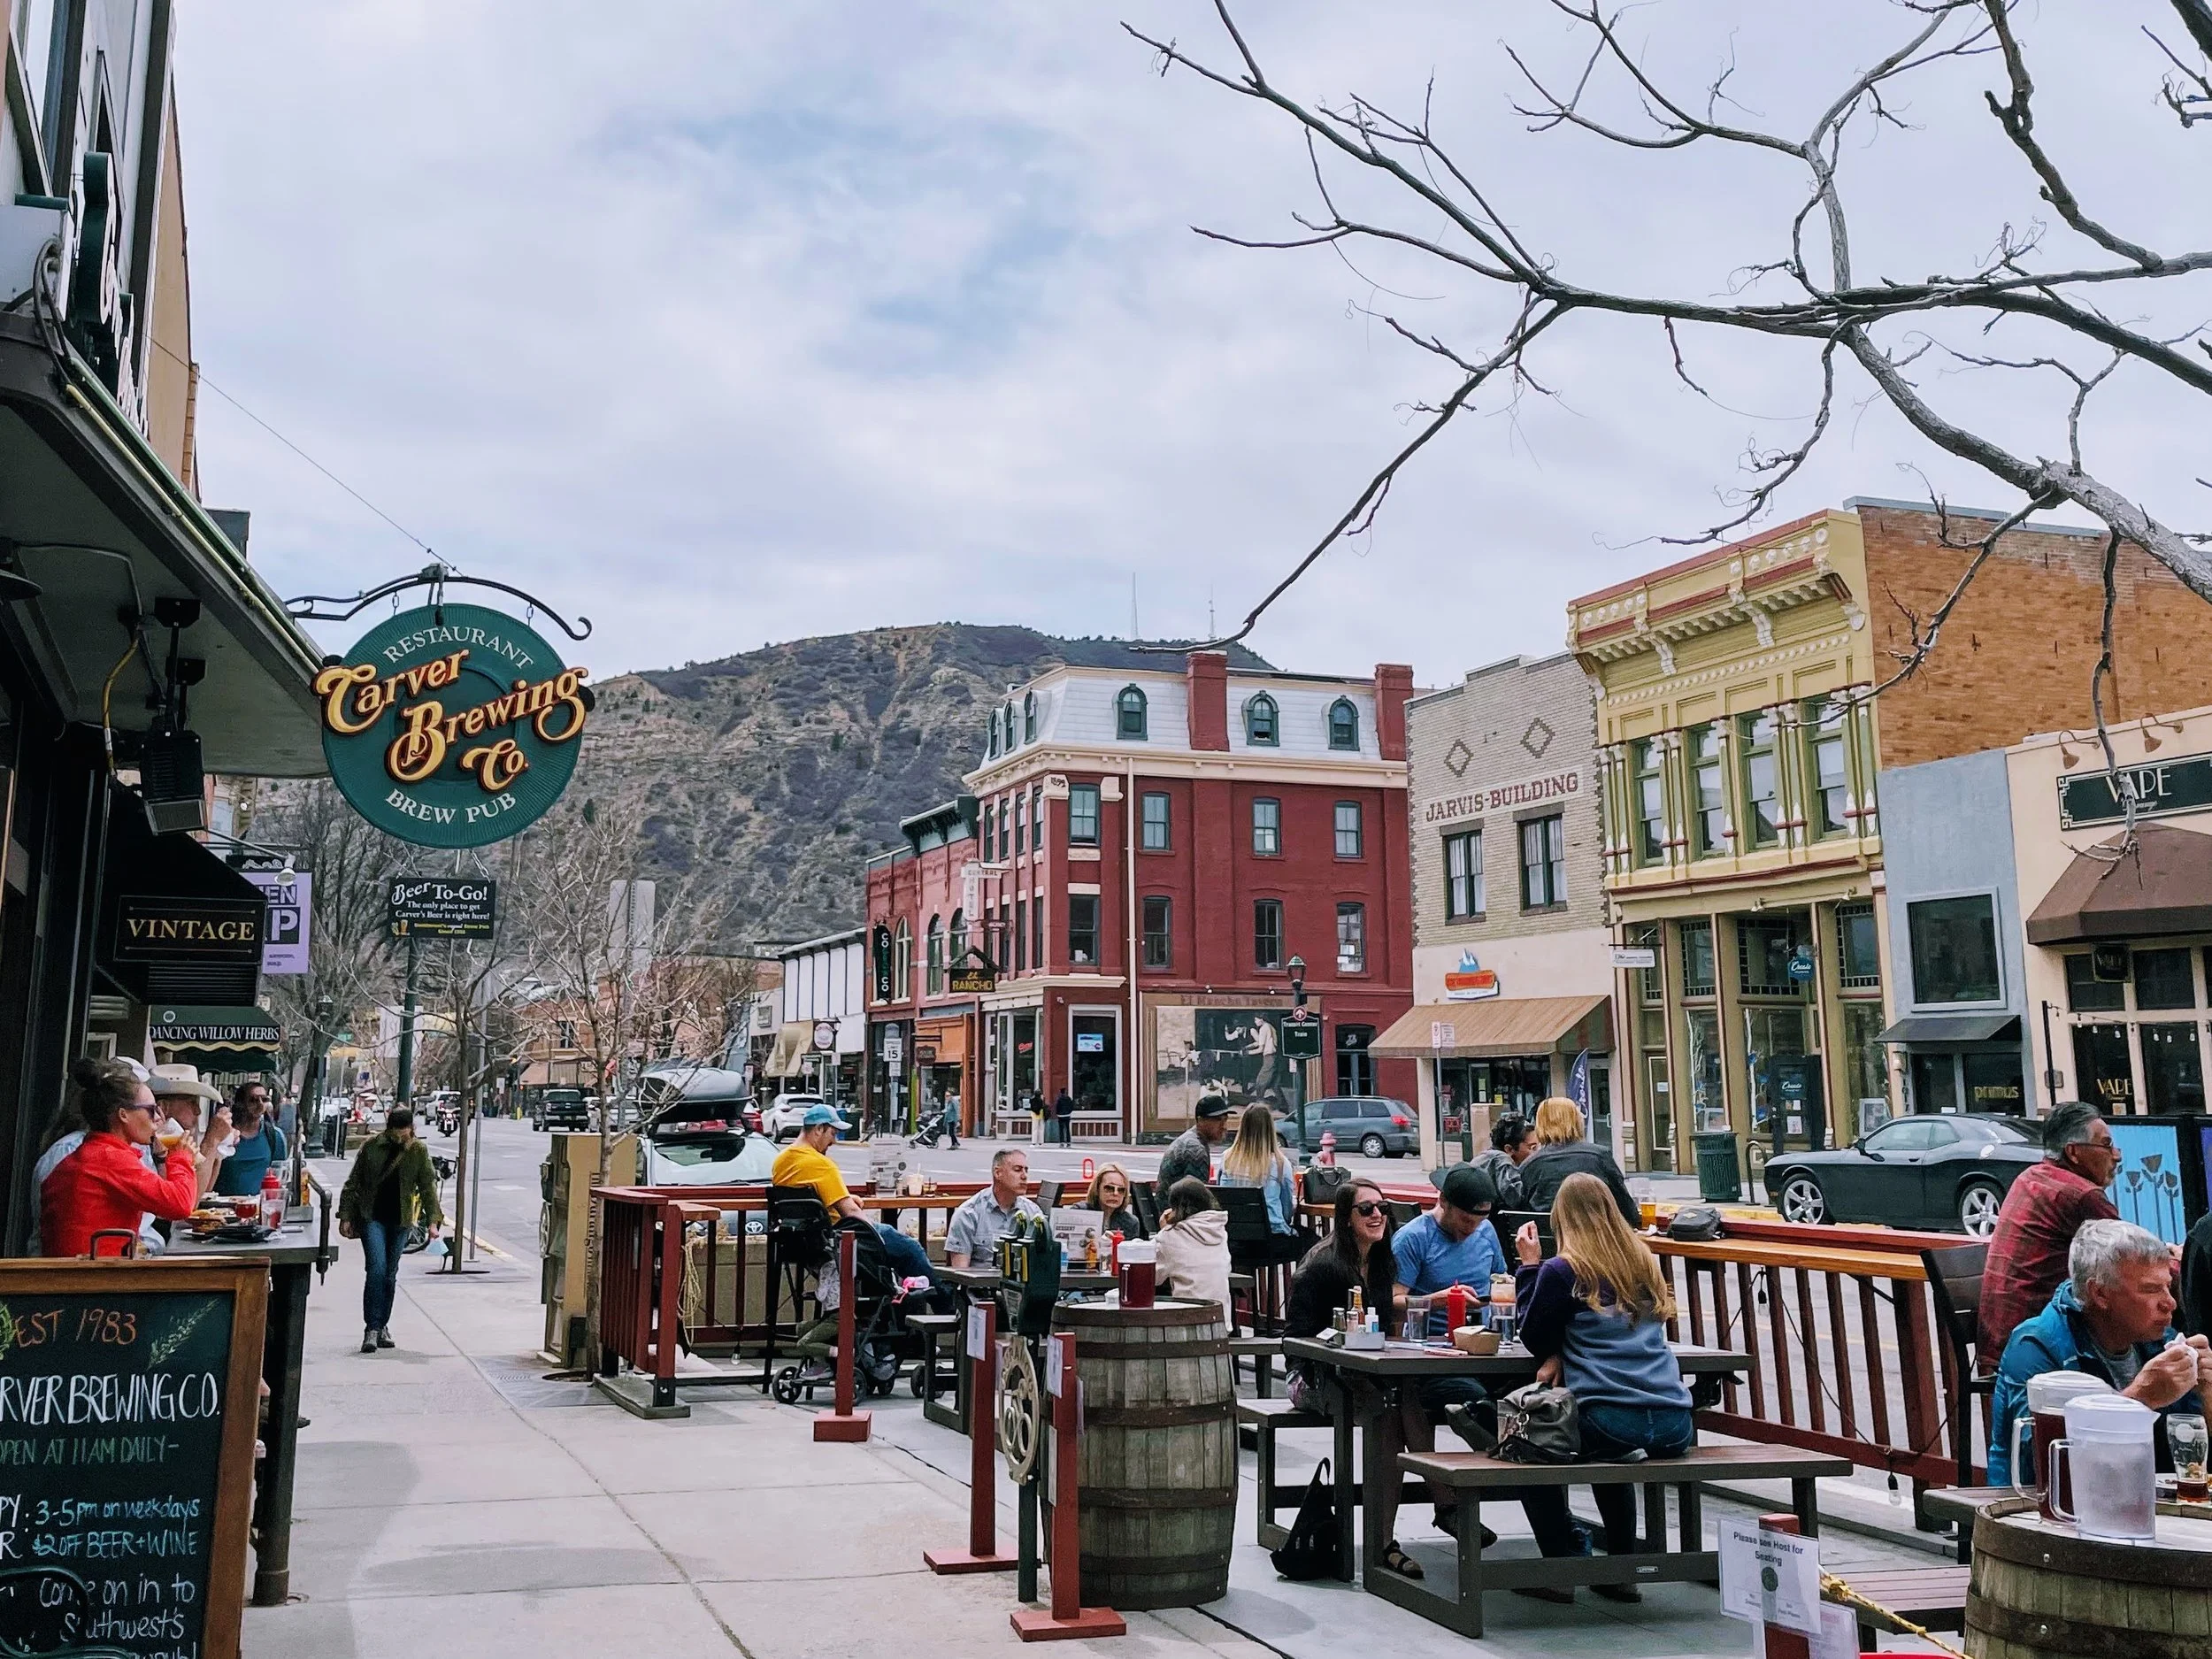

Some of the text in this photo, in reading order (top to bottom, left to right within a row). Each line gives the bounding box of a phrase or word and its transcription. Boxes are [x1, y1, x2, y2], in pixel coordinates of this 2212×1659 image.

[383, 626, 534, 670] RESTAURANT
[313, 649, 470, 735] Carver
[387, 666, 589, 782] Brewing
[461, 739, 529, 792] Co.
[385, 787, 517, 825] BREW PUB
[267, 885, 296, 904] EN
[391, 882, 488, 905] Beer To-Go!
[422, 902, 439, 910] only
[441, 902, 459, 910] place
[452, 911, 470, 921] right
[127, 918, 255, 941] VINTAGE
[952, 980, 993, 991] RANCHO
[198, 1026, 245, 1040] WILLOW
[245, 1026, 280, 1041] HERBS
[887, 1049, 899, 1059] 15
[2097, 1079, 2132, 1094] VAPE
[15, 1309, 137, 1348] EST 1983
[68, 1373, 175, 1425] BREWING
[179, 1372, 219, 1418] CO.
[43, 1438, 66, 1464] AT
[104, 1501, 120, 1517] on
[125, 1494, 201, 1528] weekdays
[1733, 1532, 1758, 1544] Please
[1773, 1540, 1791, 1551] Host
[1792, 1544, 1803, 1555] for
[1755, 1551, 1783, 1566] Seating
[104, 1579, 128, 1606] on
[138, 1572, 160, 1604] in
[172, 1572, 196, 1602] to
[59, 1607, 184, 1641] Suthwest's
